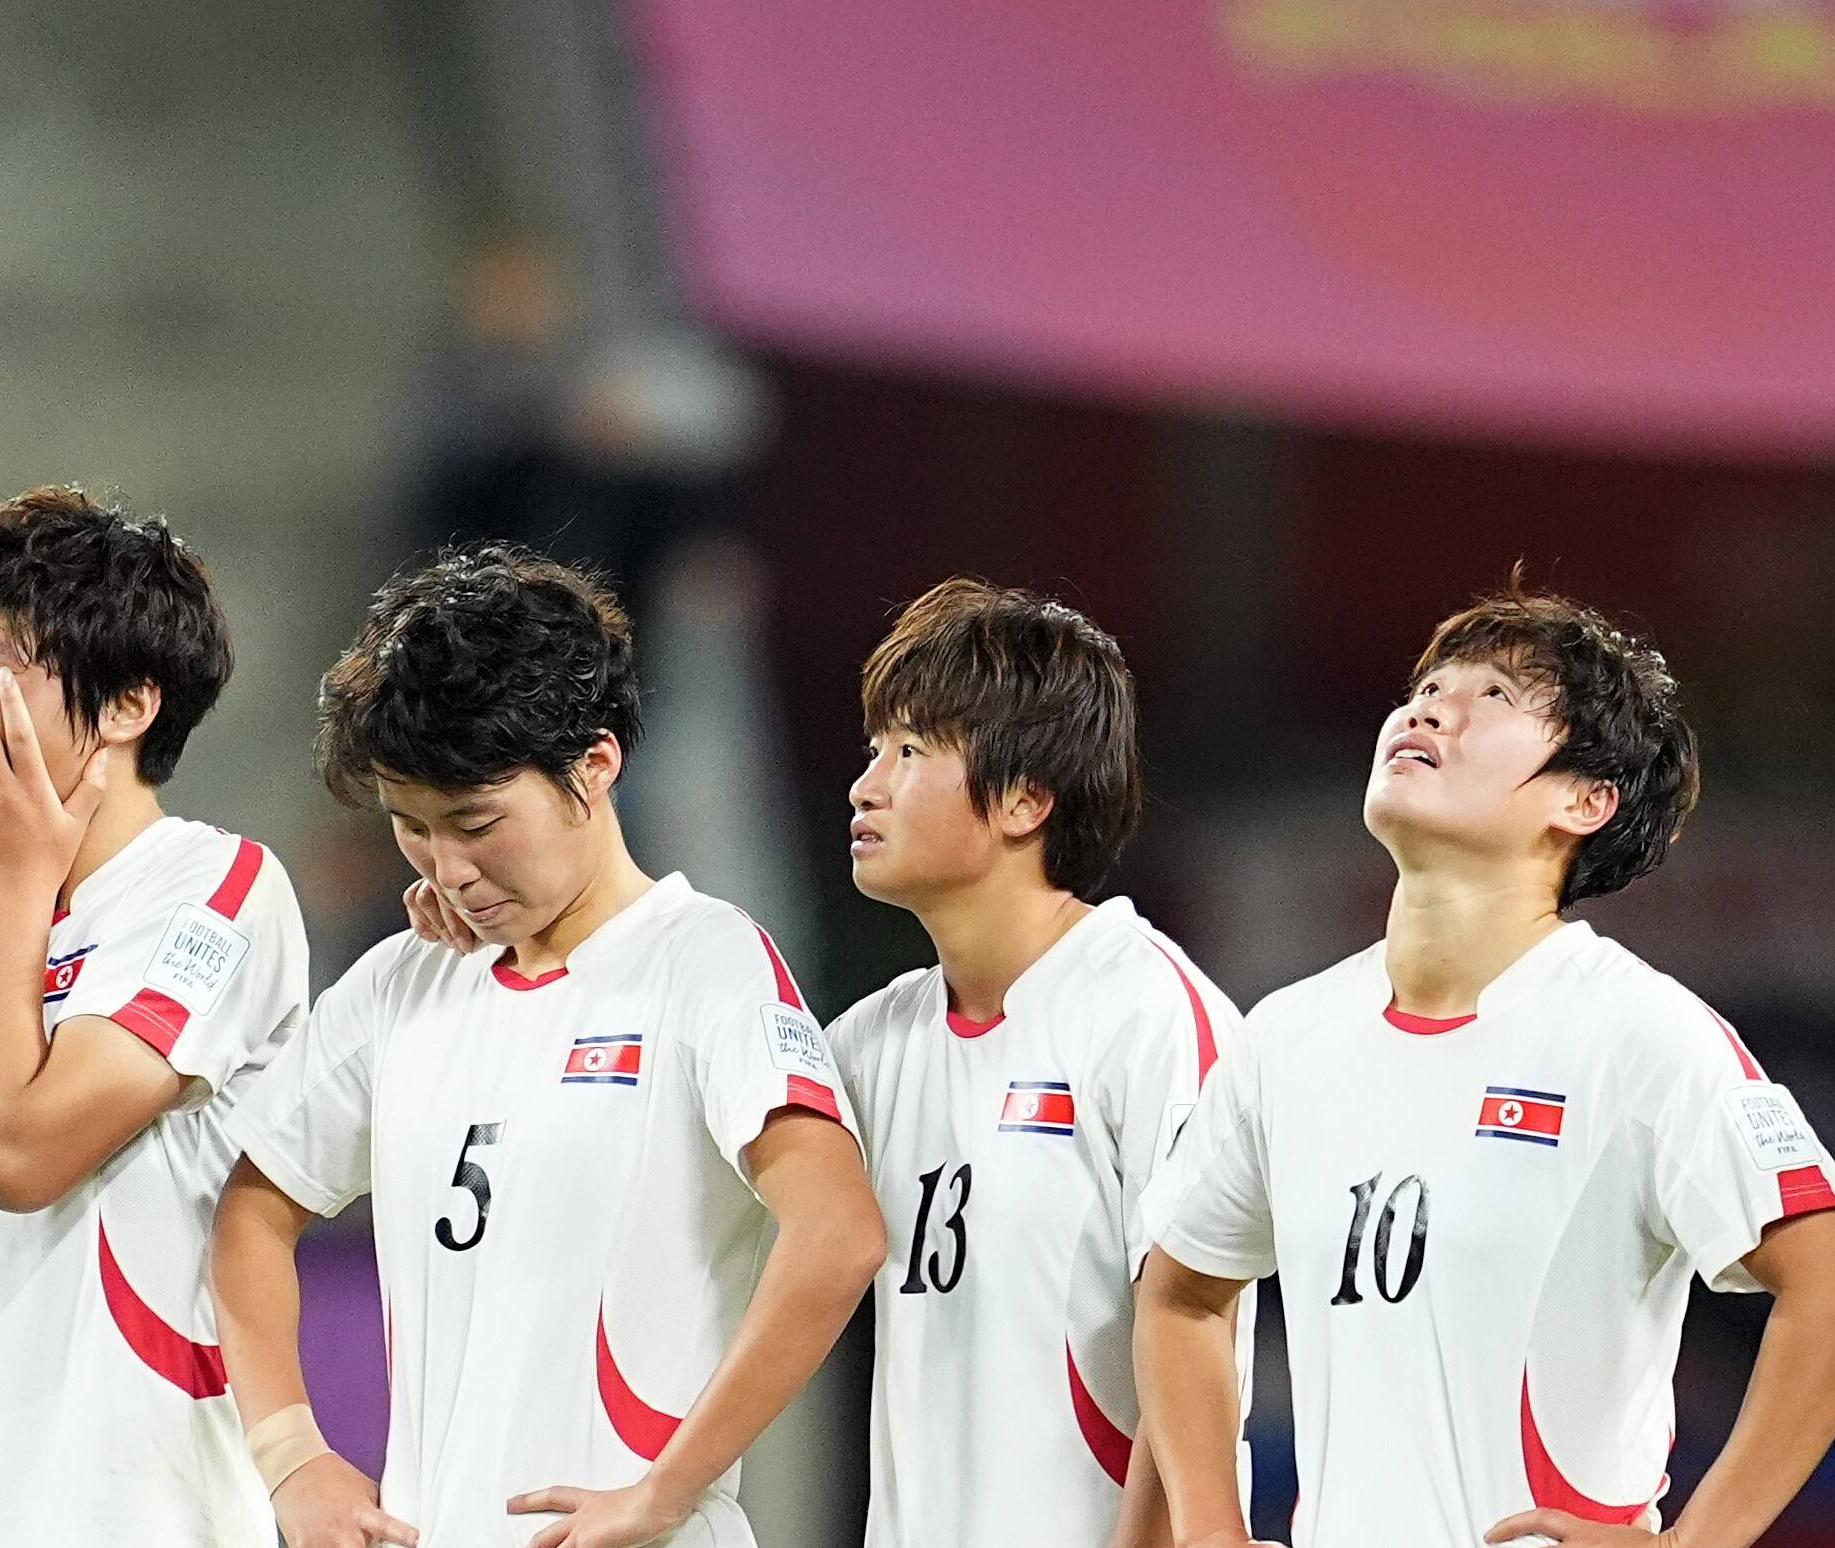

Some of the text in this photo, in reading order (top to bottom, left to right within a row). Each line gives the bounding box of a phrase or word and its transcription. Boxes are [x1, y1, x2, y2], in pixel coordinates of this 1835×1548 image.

[162, 952, 220, 992] the World
[174, 931, 226, 973] UNITES
[182, 919, 232, 957] FOOTBALL
[435, 1119, 507, 1252] 5
[900, 1160, 972, 1294] 13
[1330, 1170, 1430, 1306] 10
